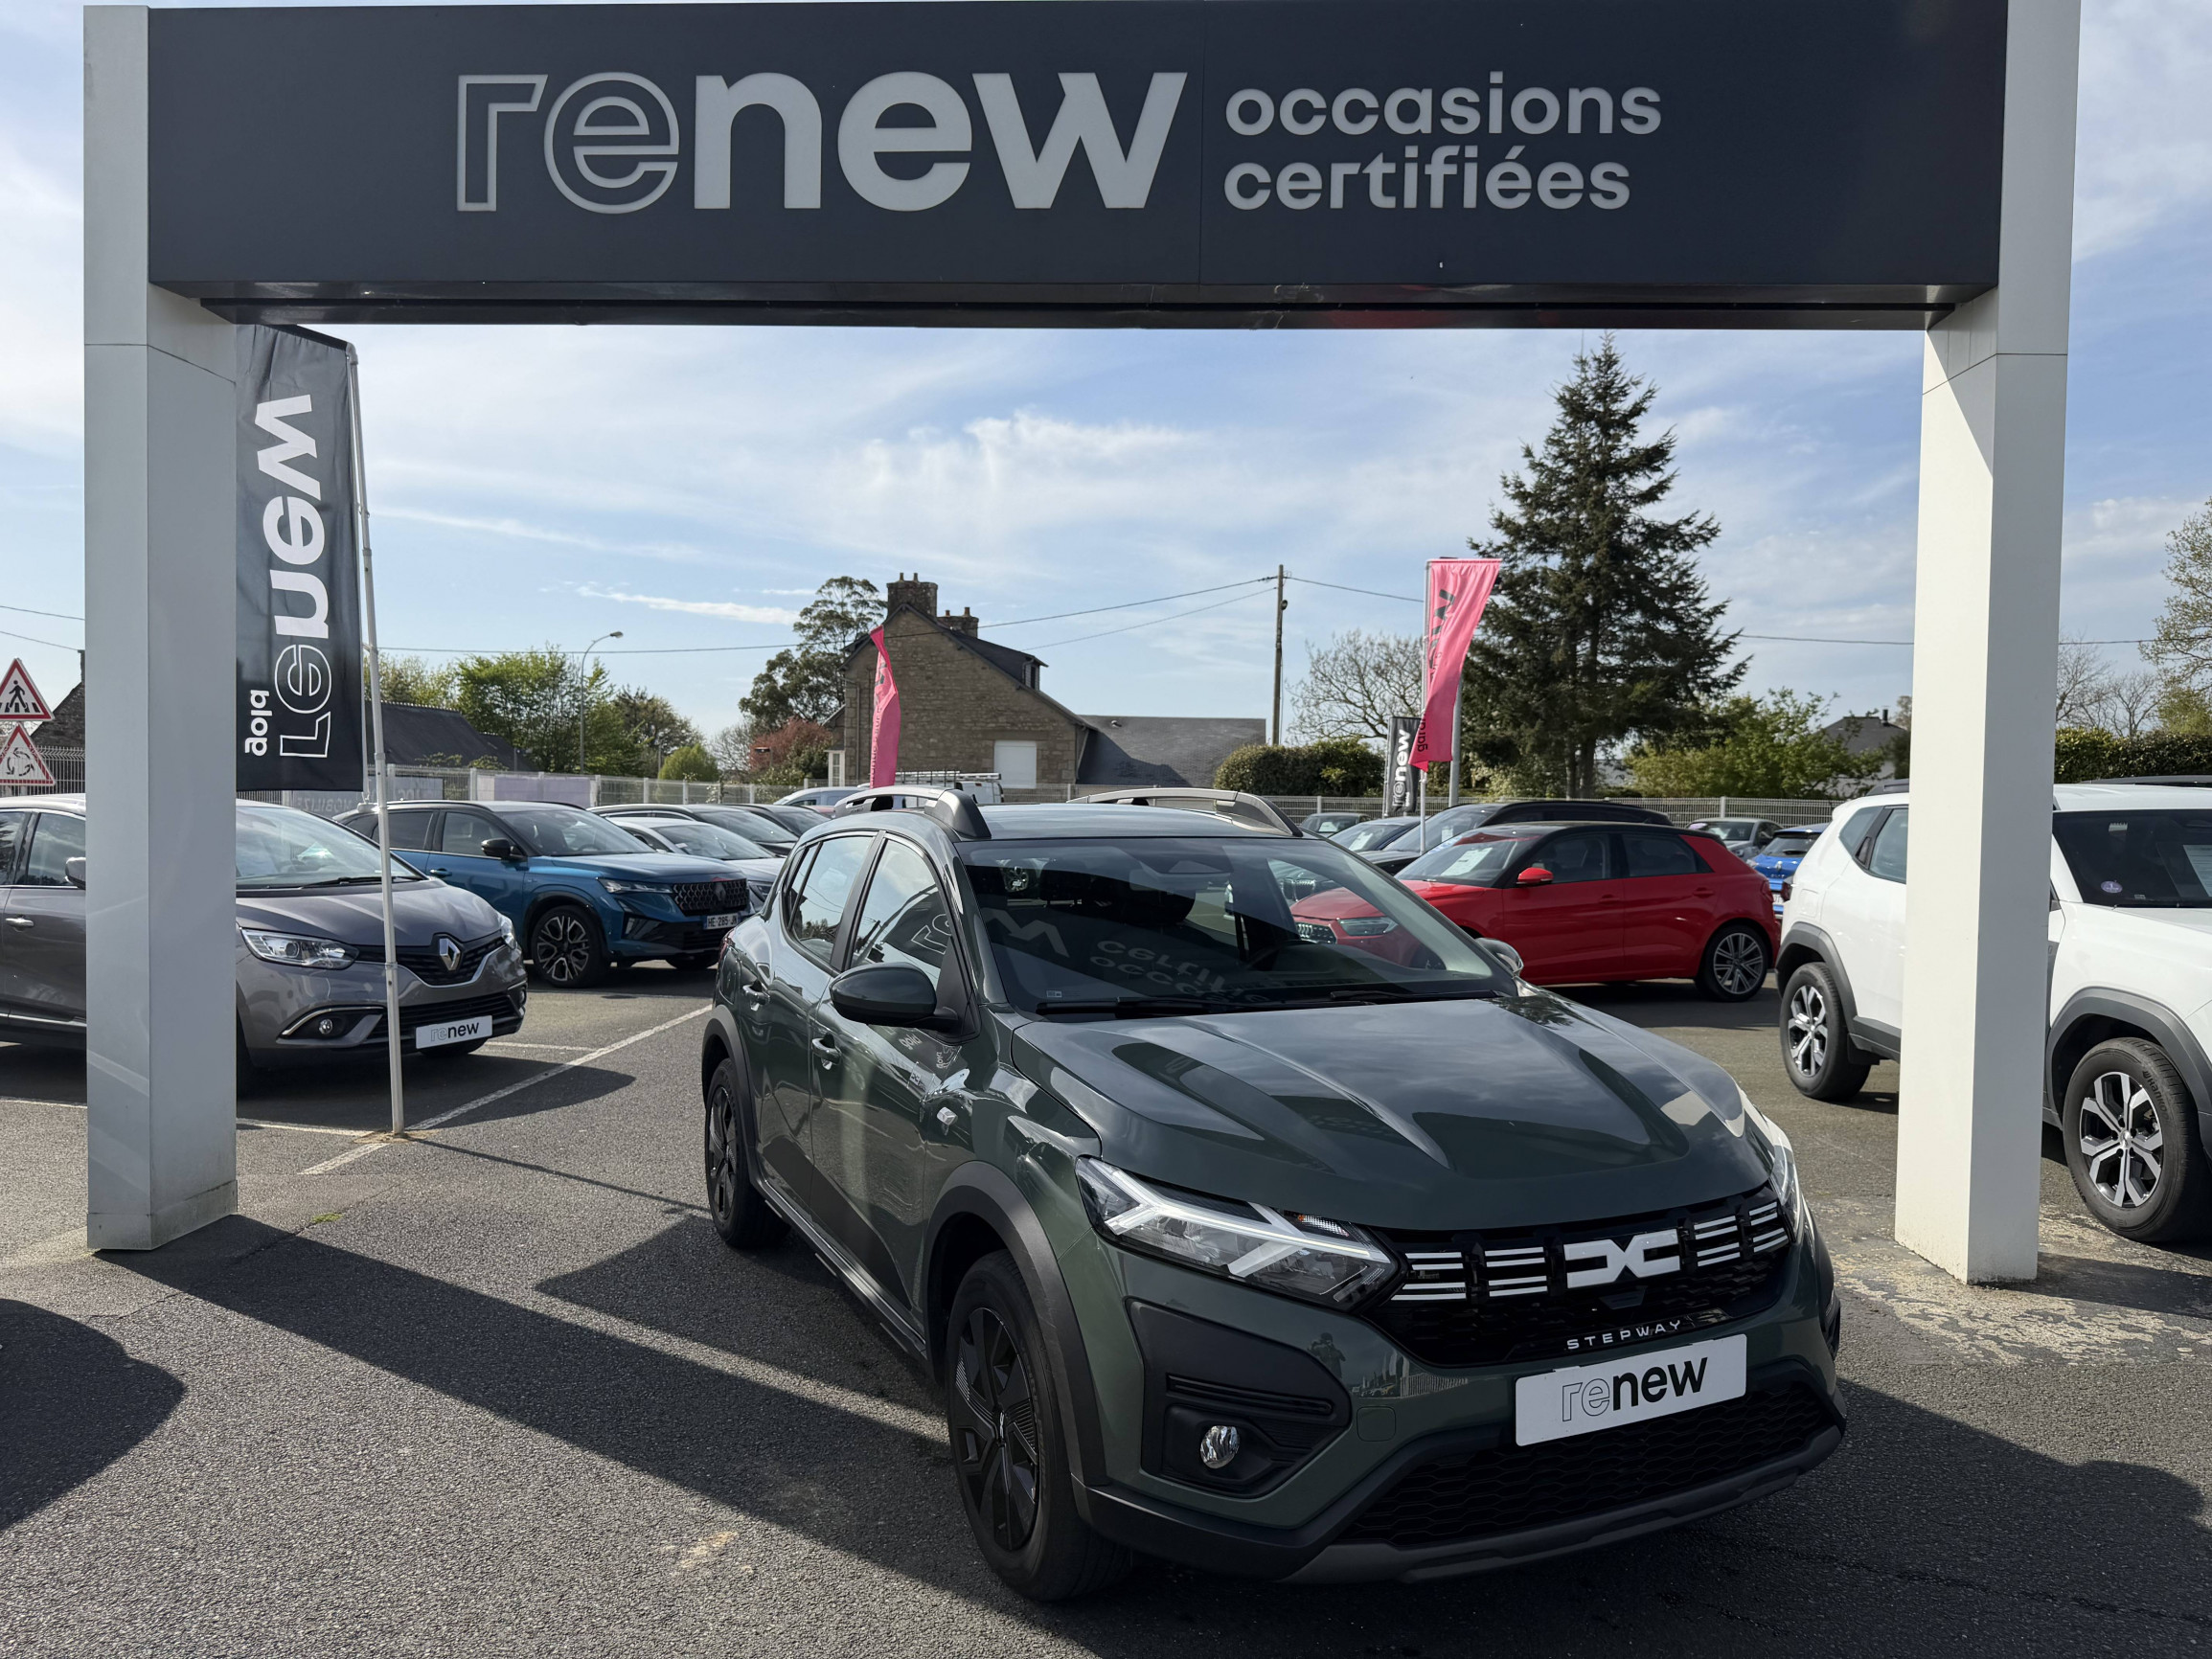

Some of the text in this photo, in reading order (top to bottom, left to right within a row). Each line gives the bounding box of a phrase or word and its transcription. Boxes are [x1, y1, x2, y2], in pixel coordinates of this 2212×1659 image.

[1225, 71, 1661, 135] occasions
[457, 71, 1188, 214] renew
[1224, 145, 1630, 210] certifiées
[1392, 729, 1411, 807] renew
[430, 1022, 480, 1042] renew
[1566, 1320, 1681, 1350] STEPWAY
[1562, 1357, 1708, 1422] renew
